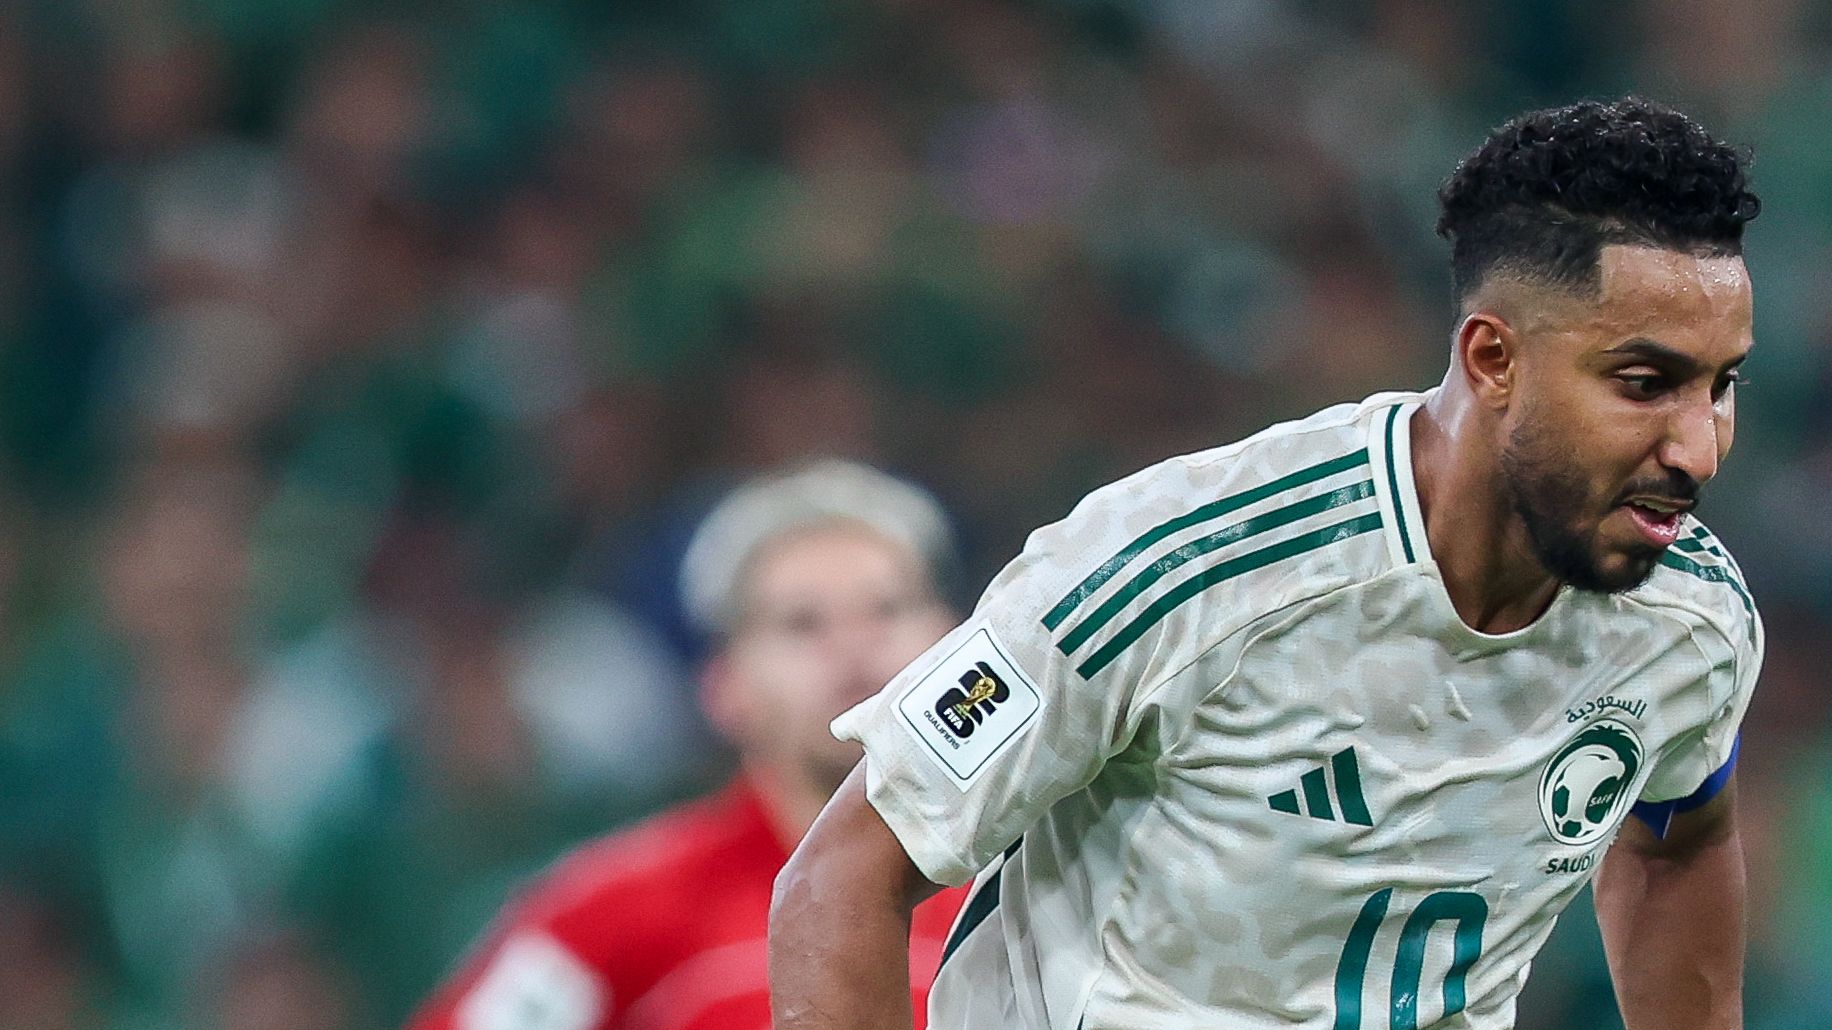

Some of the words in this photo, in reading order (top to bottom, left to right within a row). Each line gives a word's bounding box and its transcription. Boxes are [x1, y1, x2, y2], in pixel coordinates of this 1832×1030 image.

[942, 707, 964, 730] FIFA
[1565, 695, 1647, 723] السعودية
[923, 709, 961, 750] QUALIFIERS
[1545, 854, 1595, 875] SAUDI
